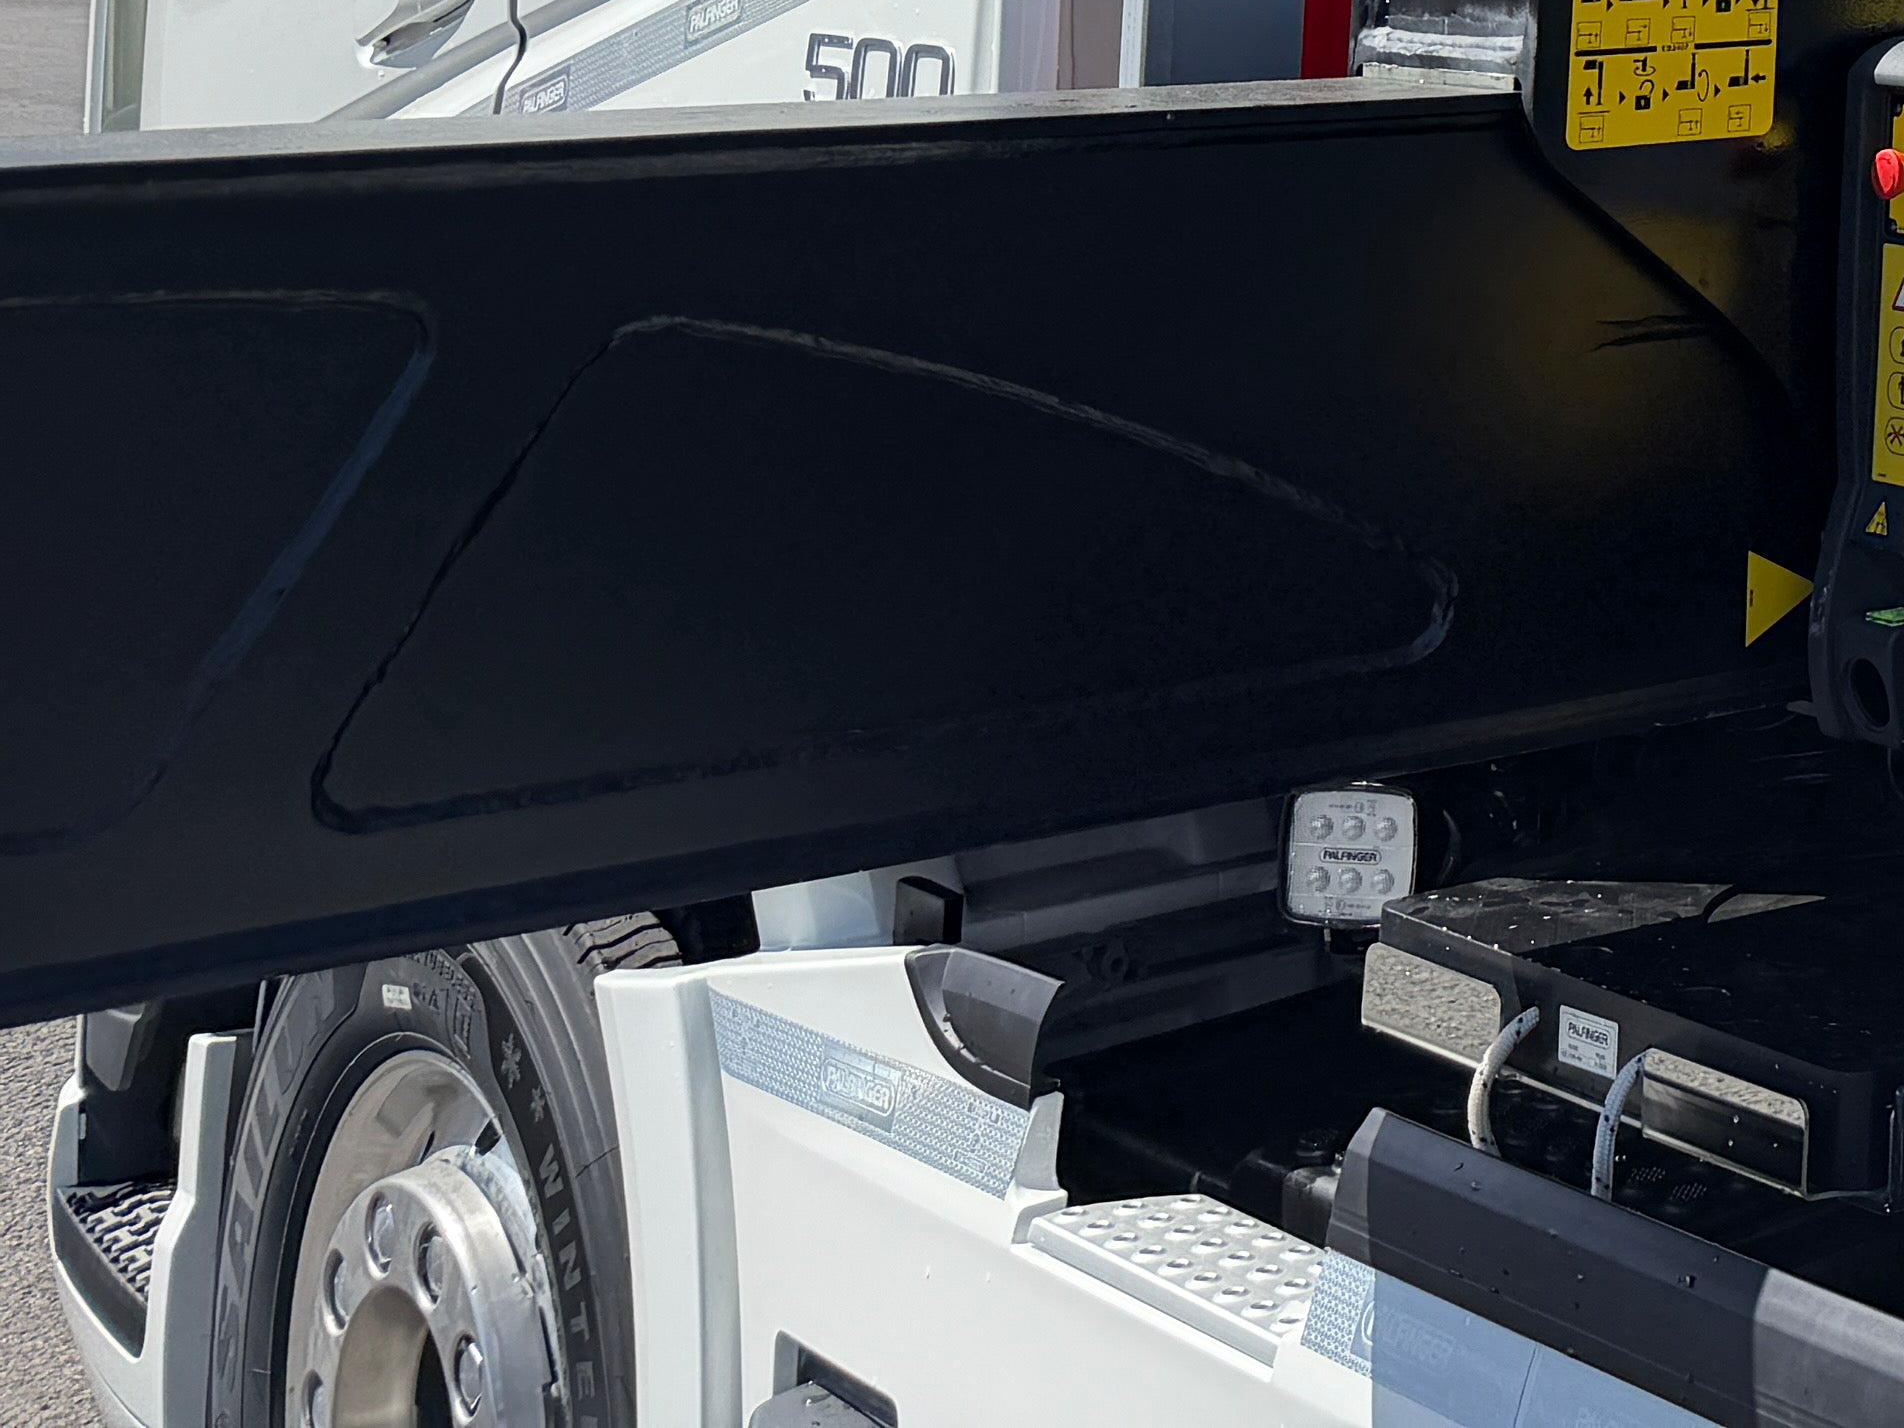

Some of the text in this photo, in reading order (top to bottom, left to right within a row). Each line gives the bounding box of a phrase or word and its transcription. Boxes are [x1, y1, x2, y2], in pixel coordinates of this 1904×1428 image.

[803, 32, 956, 103] 500
[1322, 849, 1378, 862] PALFINGER
[538, 1143, 599, 1428] WINTE
